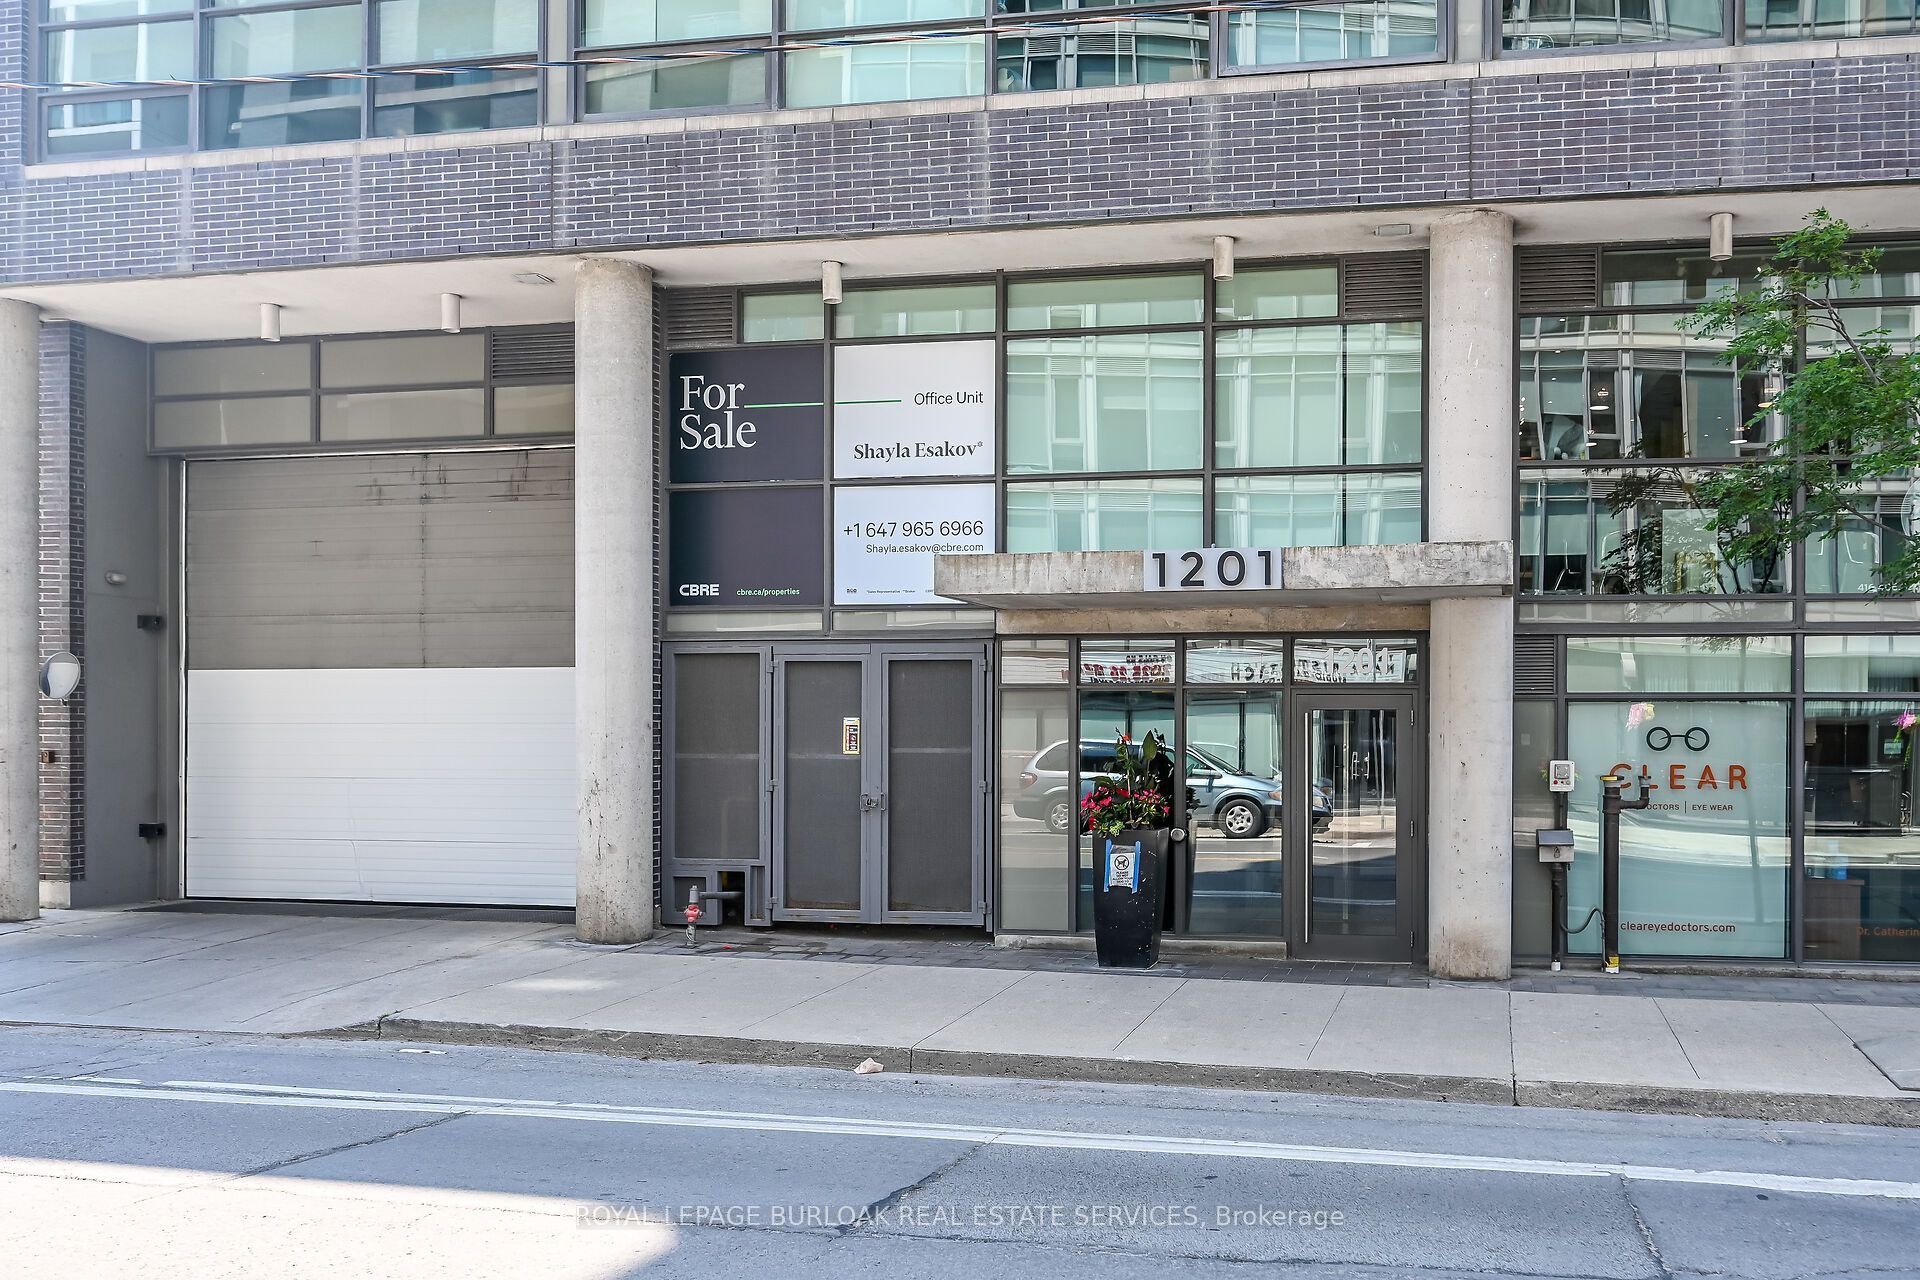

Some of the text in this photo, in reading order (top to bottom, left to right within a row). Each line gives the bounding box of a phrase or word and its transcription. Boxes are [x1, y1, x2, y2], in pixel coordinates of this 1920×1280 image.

[680, 375, 745, 411] For
[914, 391, 984, 405] Office Unit
[680, 410, 757, 450] Sale
[853, 442, 911, 463] Shayla
[843, 520, 984, 538] +1 647 965 6966
[866, 543, 984, 555] Shayla.esakov@cbre.com
[1152, 550, 1271, 588] 1201
[679, 583, 800, 597] CBRE cbre.ca/properties
[1322, 648, 1389, 675] 1201
[1646, 803, 1680, 811] OCTORS
[1620, 921, 1736, 933] cleareyedoctors.com
